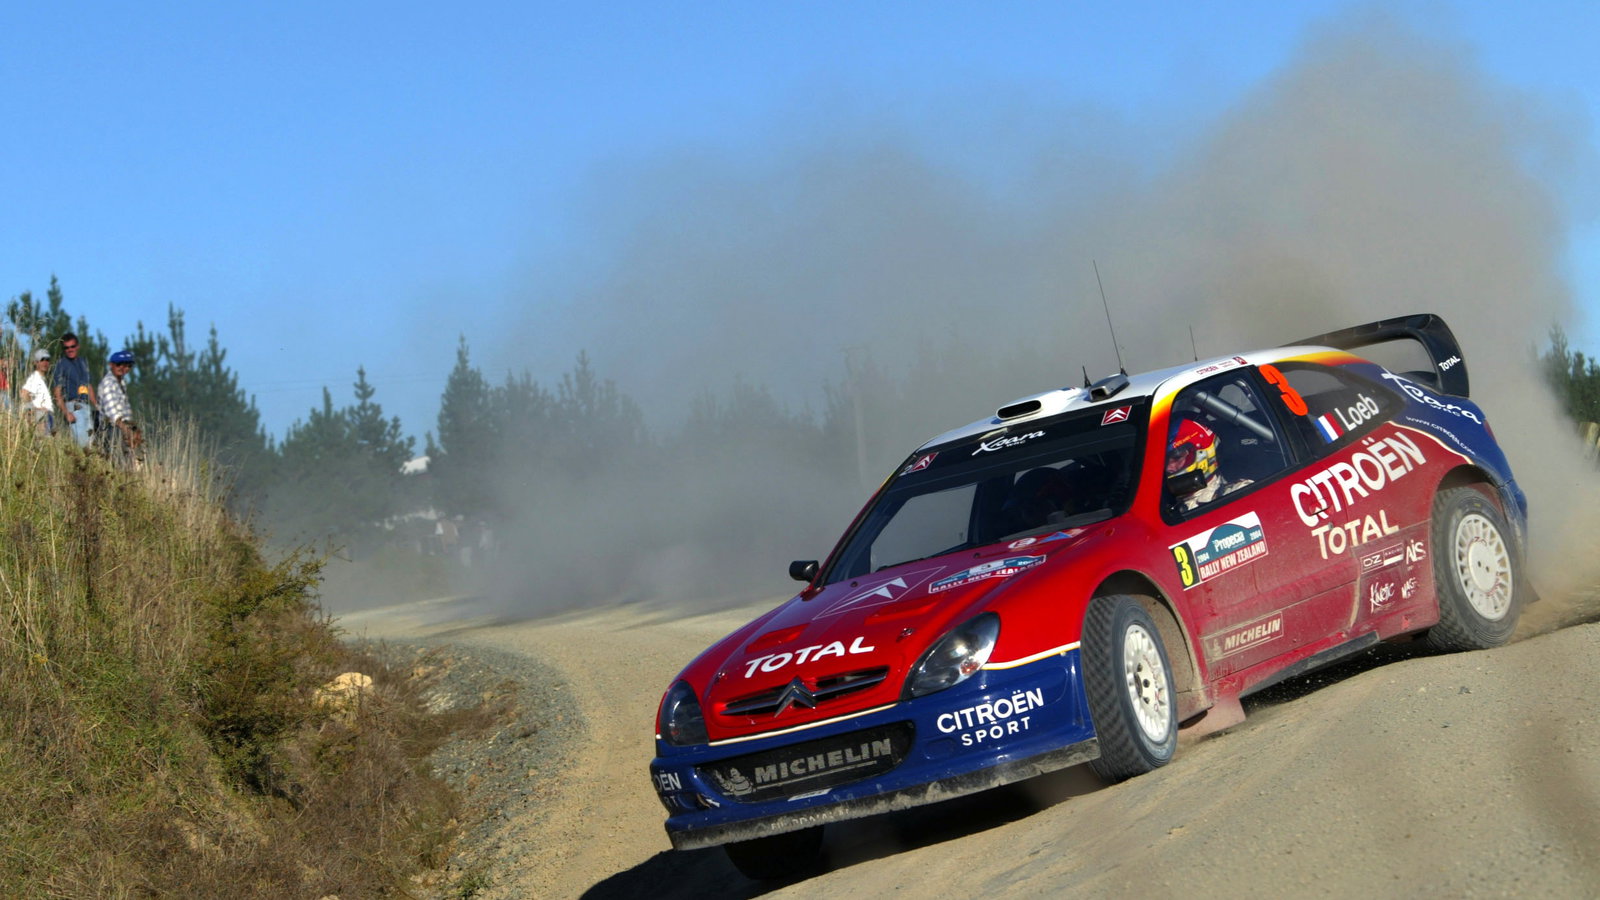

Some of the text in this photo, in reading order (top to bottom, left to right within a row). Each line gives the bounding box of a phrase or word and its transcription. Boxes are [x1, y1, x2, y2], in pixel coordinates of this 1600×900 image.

[1438, 355, 1461, 372] TOTAL
[1258, 364, 1309, 416] 3
[1334, 393, 1380, 431] Loeb
[1290, 431, 1427, 527] CITROËN
[1213, 531, 1245, 552] Propecia
[1249, 530, 1262, 541] 2004
[1311, 510, 1400, 560] TOTAL
[1173, 546, 1194, 587] 3
[1200, 560, 1220, 579] RALLY
[1220, 554, 1237, 571] NEW
[1236, 541, 1266, 563] ZEALAND
[1363, 554, 1382, 567] OZ
[932, 580, 964, 593] RALLY
[967, 572, 992, 583] NEW
[1224, 618, 1281, 650] MICHELIN
[744, 636, 875, 678] TOTAL
[937, 688, 1044, 733] CITROËN
[961, 716, 1031, 746] SPORT
[754, 738, 892, 784] MICHELIN
